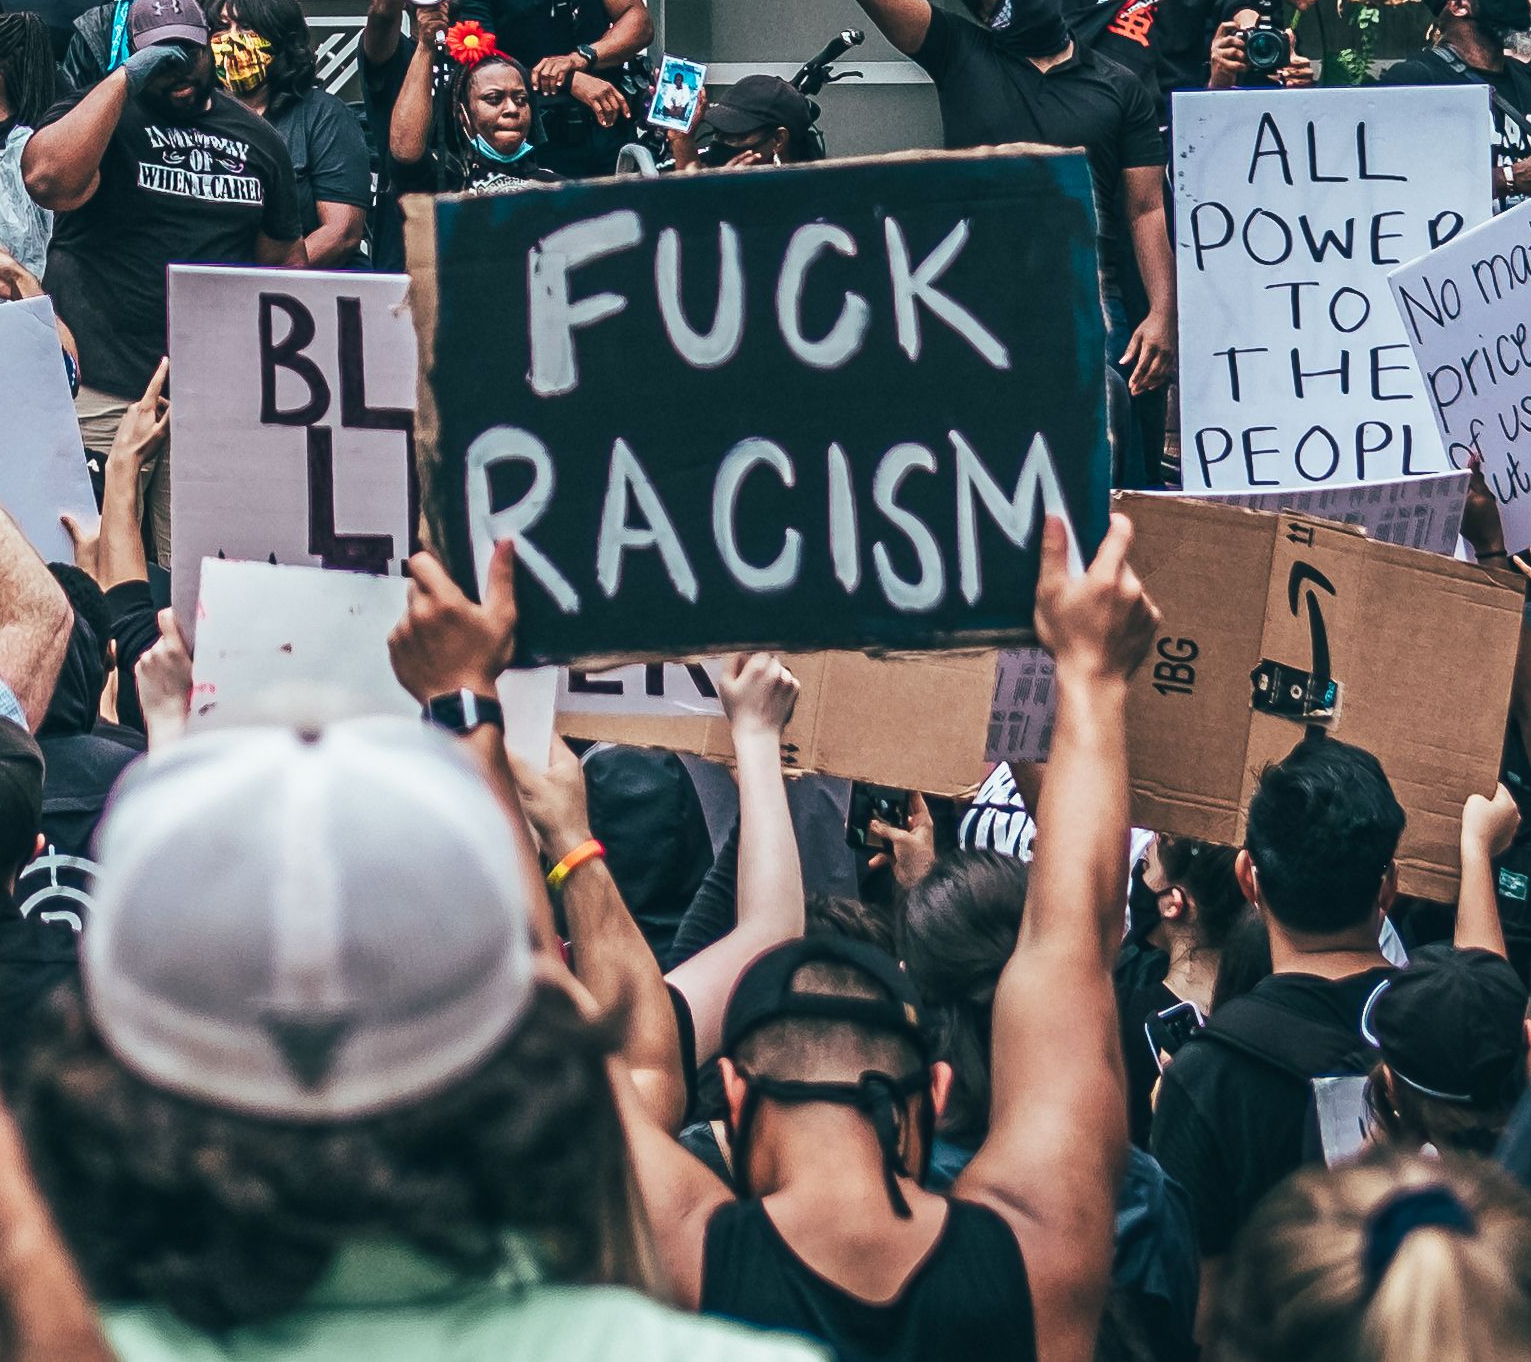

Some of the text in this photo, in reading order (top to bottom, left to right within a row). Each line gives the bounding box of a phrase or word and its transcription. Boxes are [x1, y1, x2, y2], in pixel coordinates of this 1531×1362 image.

[189, 149, 214, 172] OF
[1247, 111, 1408, 186] ALL
[141, 166, 193, 197] WHEN
[527, 208, 1012, 396] FUCK
[1264, 281, 1371, 334] TO
[1397, 275, 1462, 346] No
[1212, 343, 1415, 403] THE
[465, 427, 1086, 615] RACISM
[1152, 635, 1200, 697] 1BG
